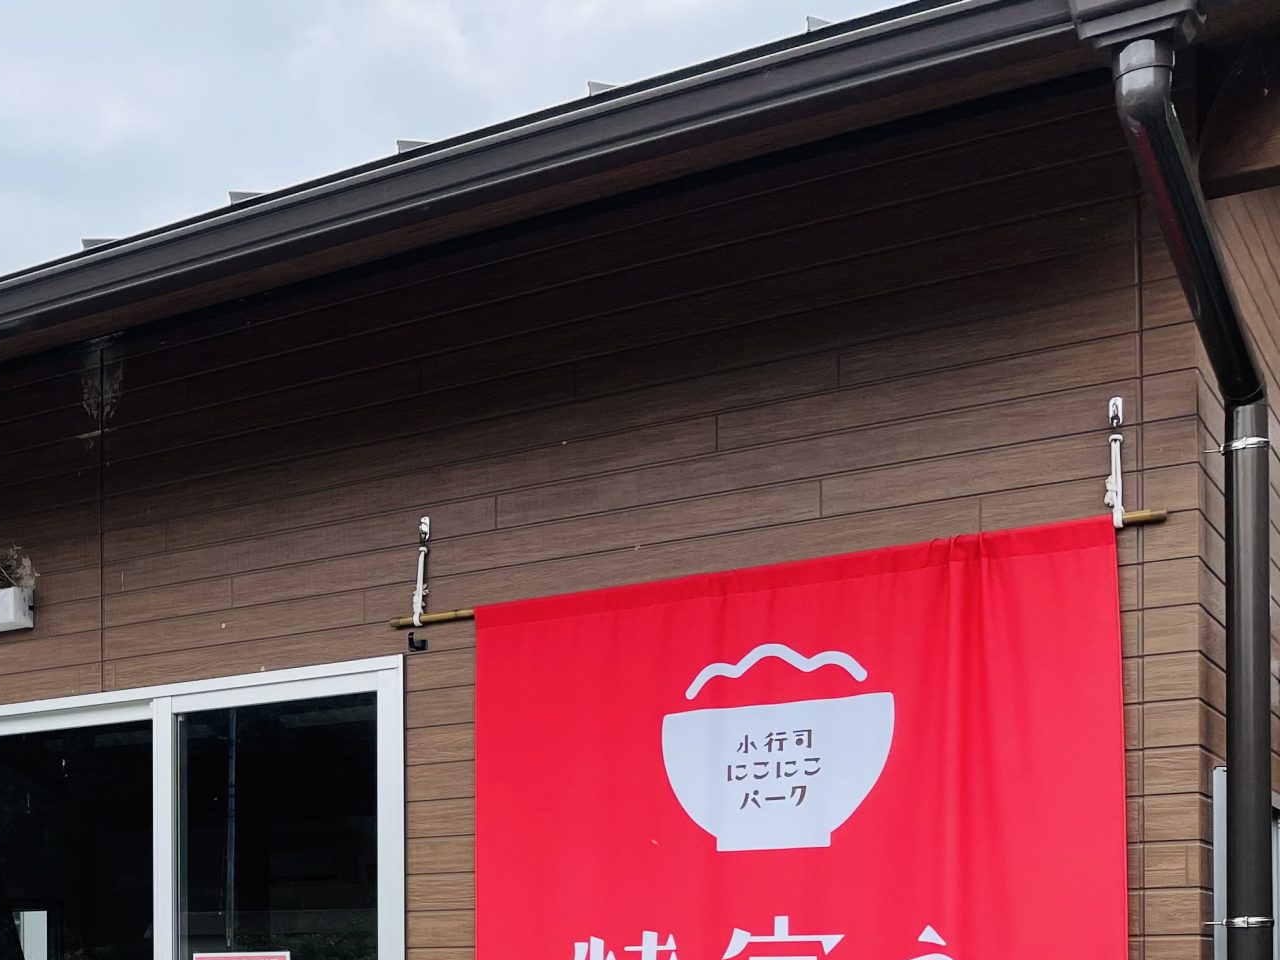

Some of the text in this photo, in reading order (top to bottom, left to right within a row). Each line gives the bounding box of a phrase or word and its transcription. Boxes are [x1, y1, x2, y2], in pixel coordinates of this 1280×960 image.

[736, 729, 812, 753] 小行司
[727, 757, 821, 781] にこにこ
[740, 785, 807, 810] パーク
